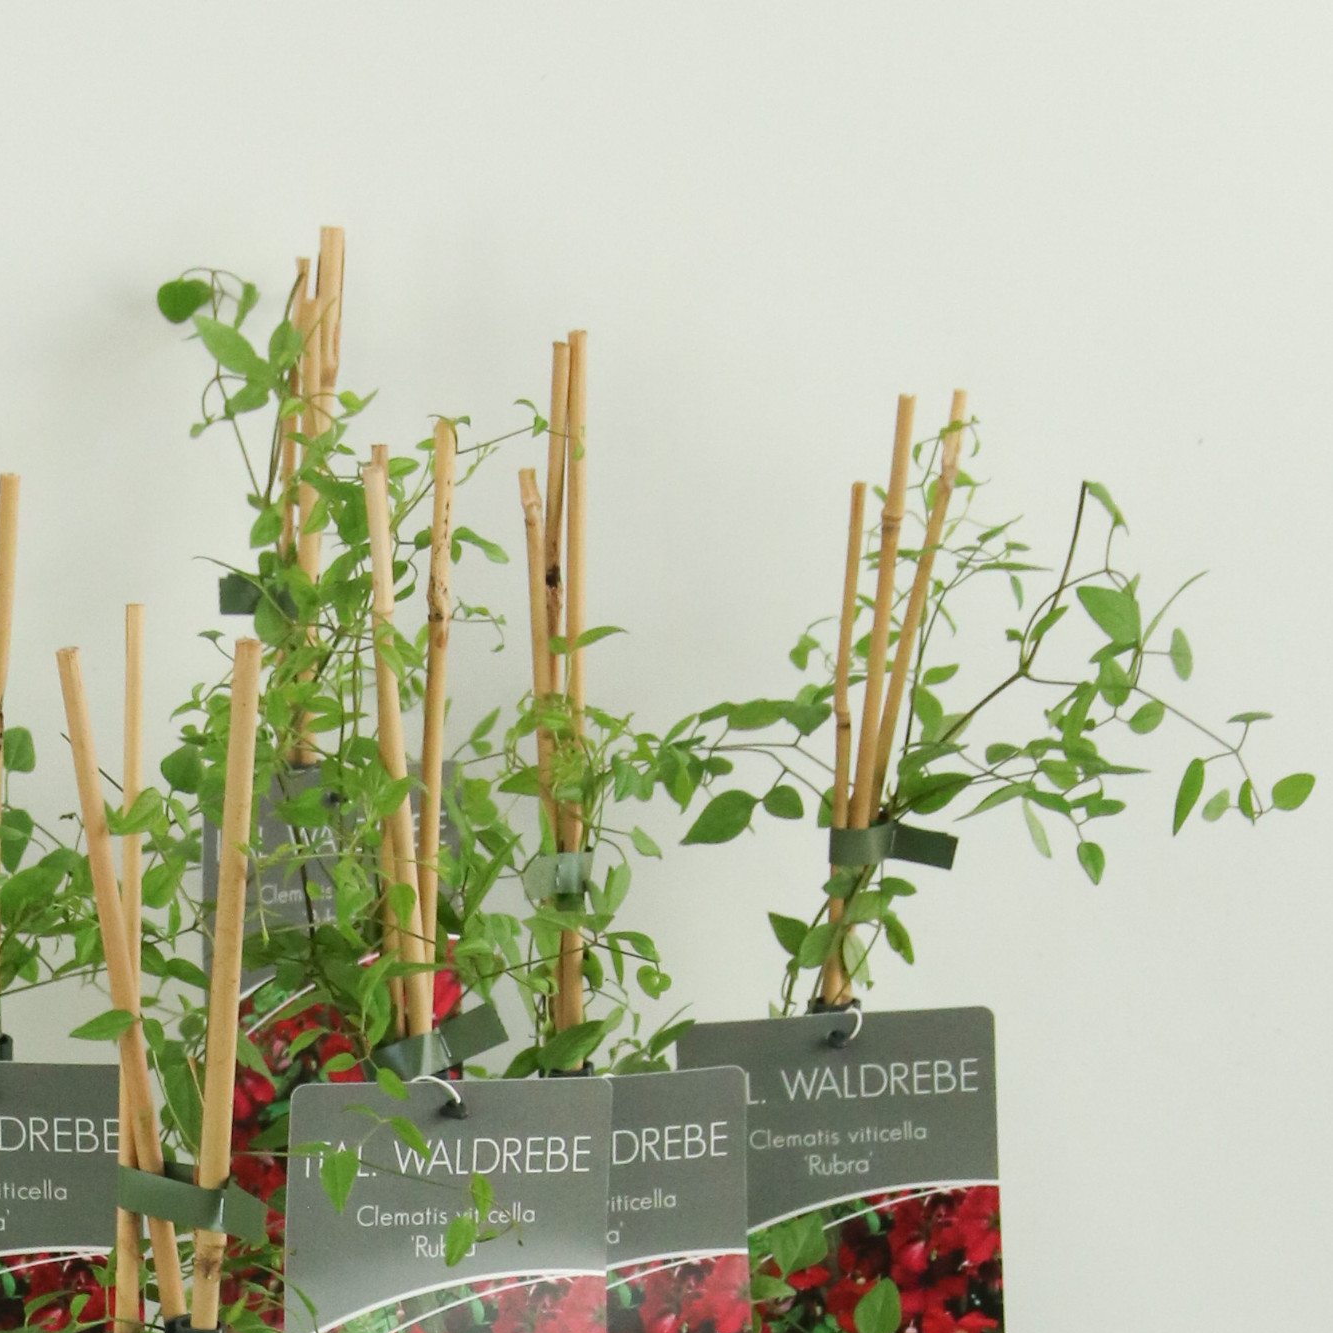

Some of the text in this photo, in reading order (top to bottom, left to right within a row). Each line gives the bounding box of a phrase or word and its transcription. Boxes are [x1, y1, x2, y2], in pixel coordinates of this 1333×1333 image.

[780, 1058, 980, 1101] WALDREBE
[612, 1121, 728, 1165] DREBE
[749, 1121, 928, 1150] Clematis viticella
[394, 1136, 592, 1176] WALDREBE
[804, 1152, 874, 1176] 'Rubra'
[357, 1202, 536, 1227] Clematis itcella
[607, 1188, 676, 1212] iticella
